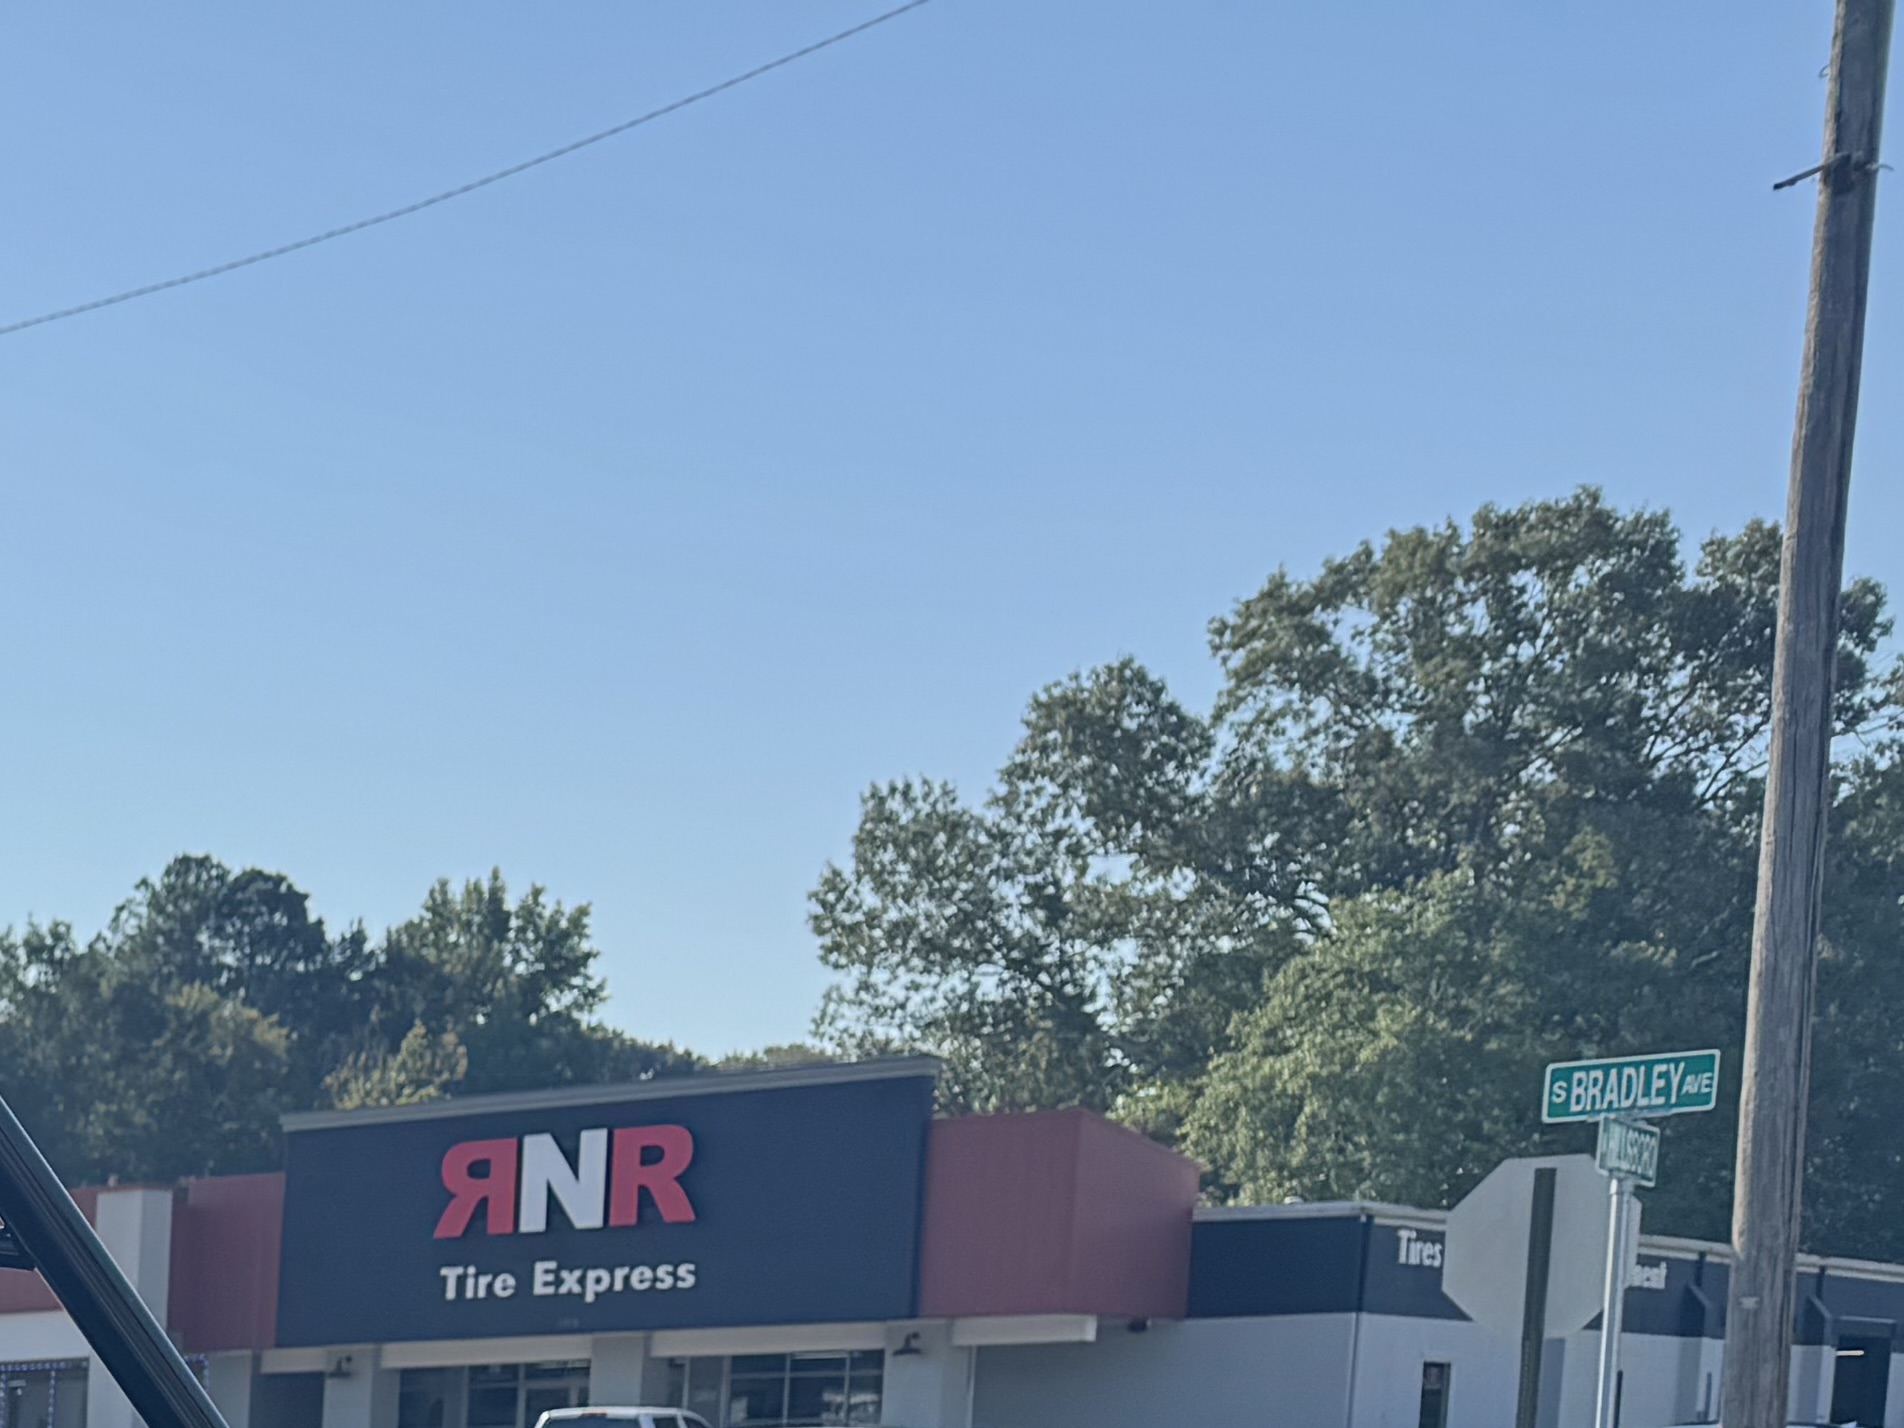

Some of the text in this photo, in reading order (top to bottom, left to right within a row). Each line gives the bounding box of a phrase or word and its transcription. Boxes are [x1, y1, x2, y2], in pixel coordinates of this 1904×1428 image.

[1552, 1062, 1713, 1112] S BRADLEY AVE
[433, 1124, 696, 1239] RNR
[1397, 1229, 1442, 1267] Tires
[440, 1261, 696, 1303] Tire Express
